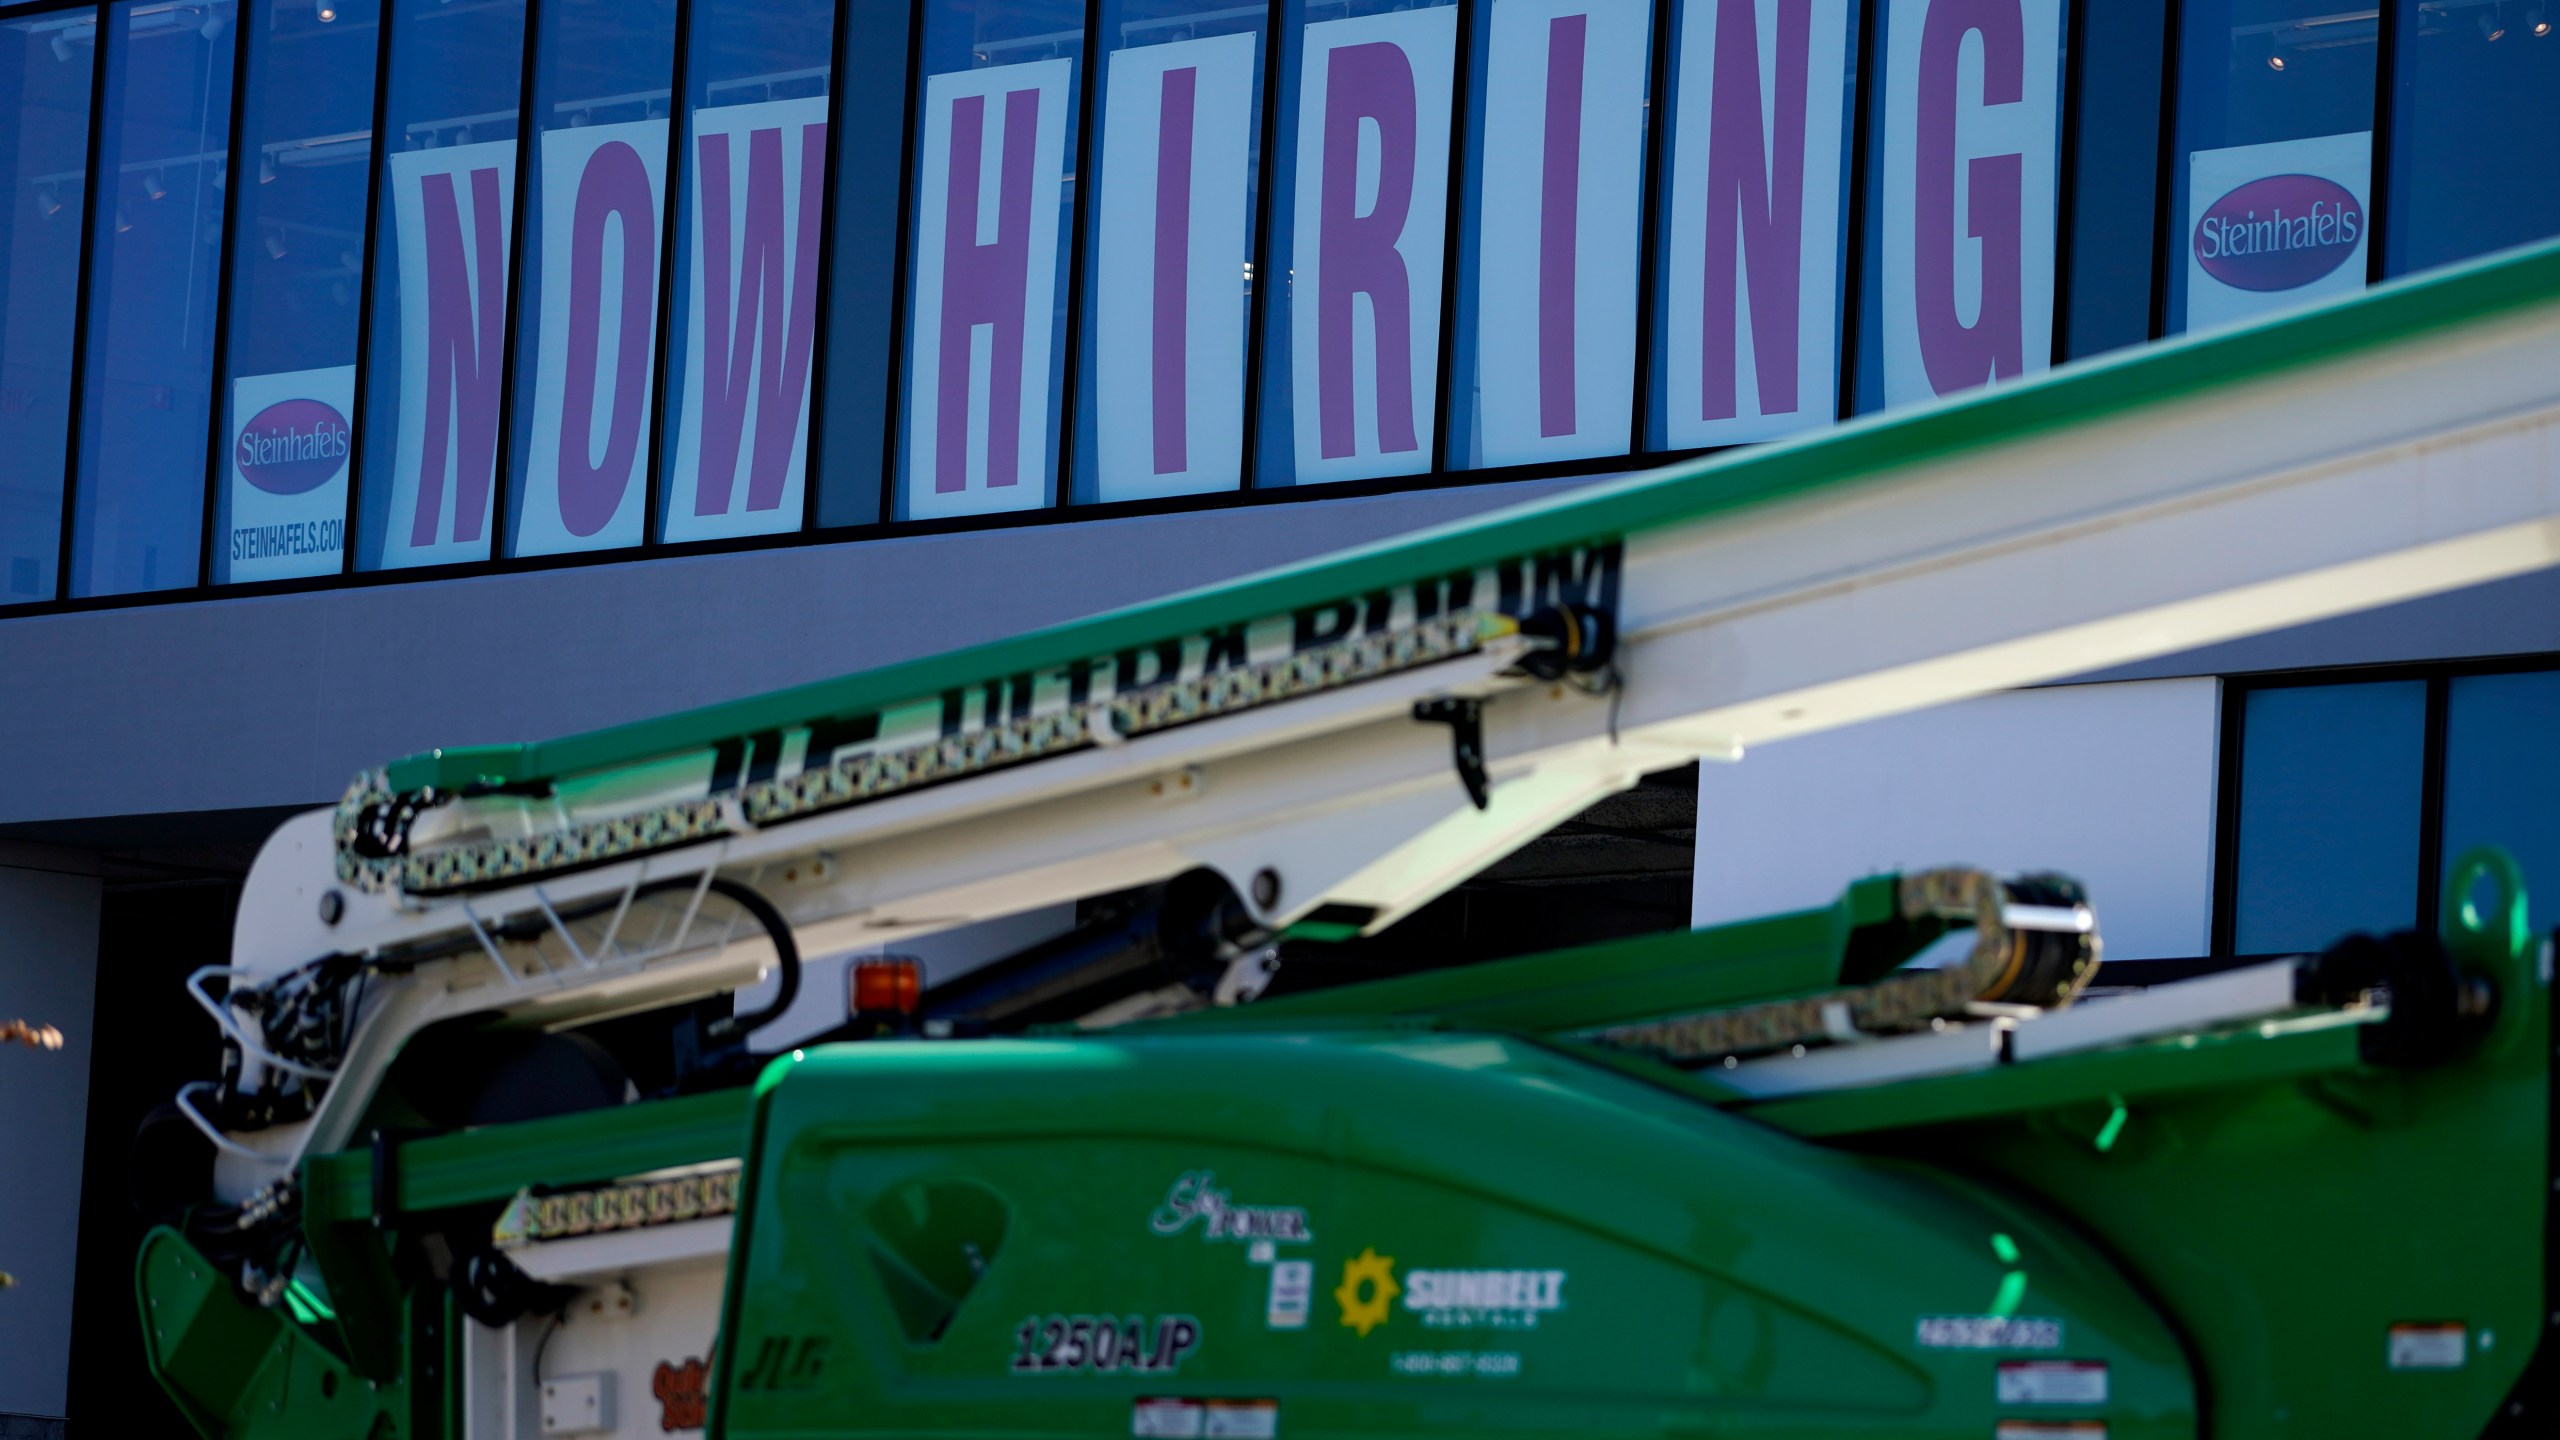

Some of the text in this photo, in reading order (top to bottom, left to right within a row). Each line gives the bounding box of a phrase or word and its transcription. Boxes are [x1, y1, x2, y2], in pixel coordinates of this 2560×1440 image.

[2201, 201, 2357, 259] Steinhafels
[410, 0, 2025, 547] NOW HIRING
[241, 421, 346, 467] Steinhafels
[1405, 1270, 1565, 1310] SUNBELT
[739, 1336, 829, 1391] JLG
[1012, 1316, 1199, 1371] 1250AJP
